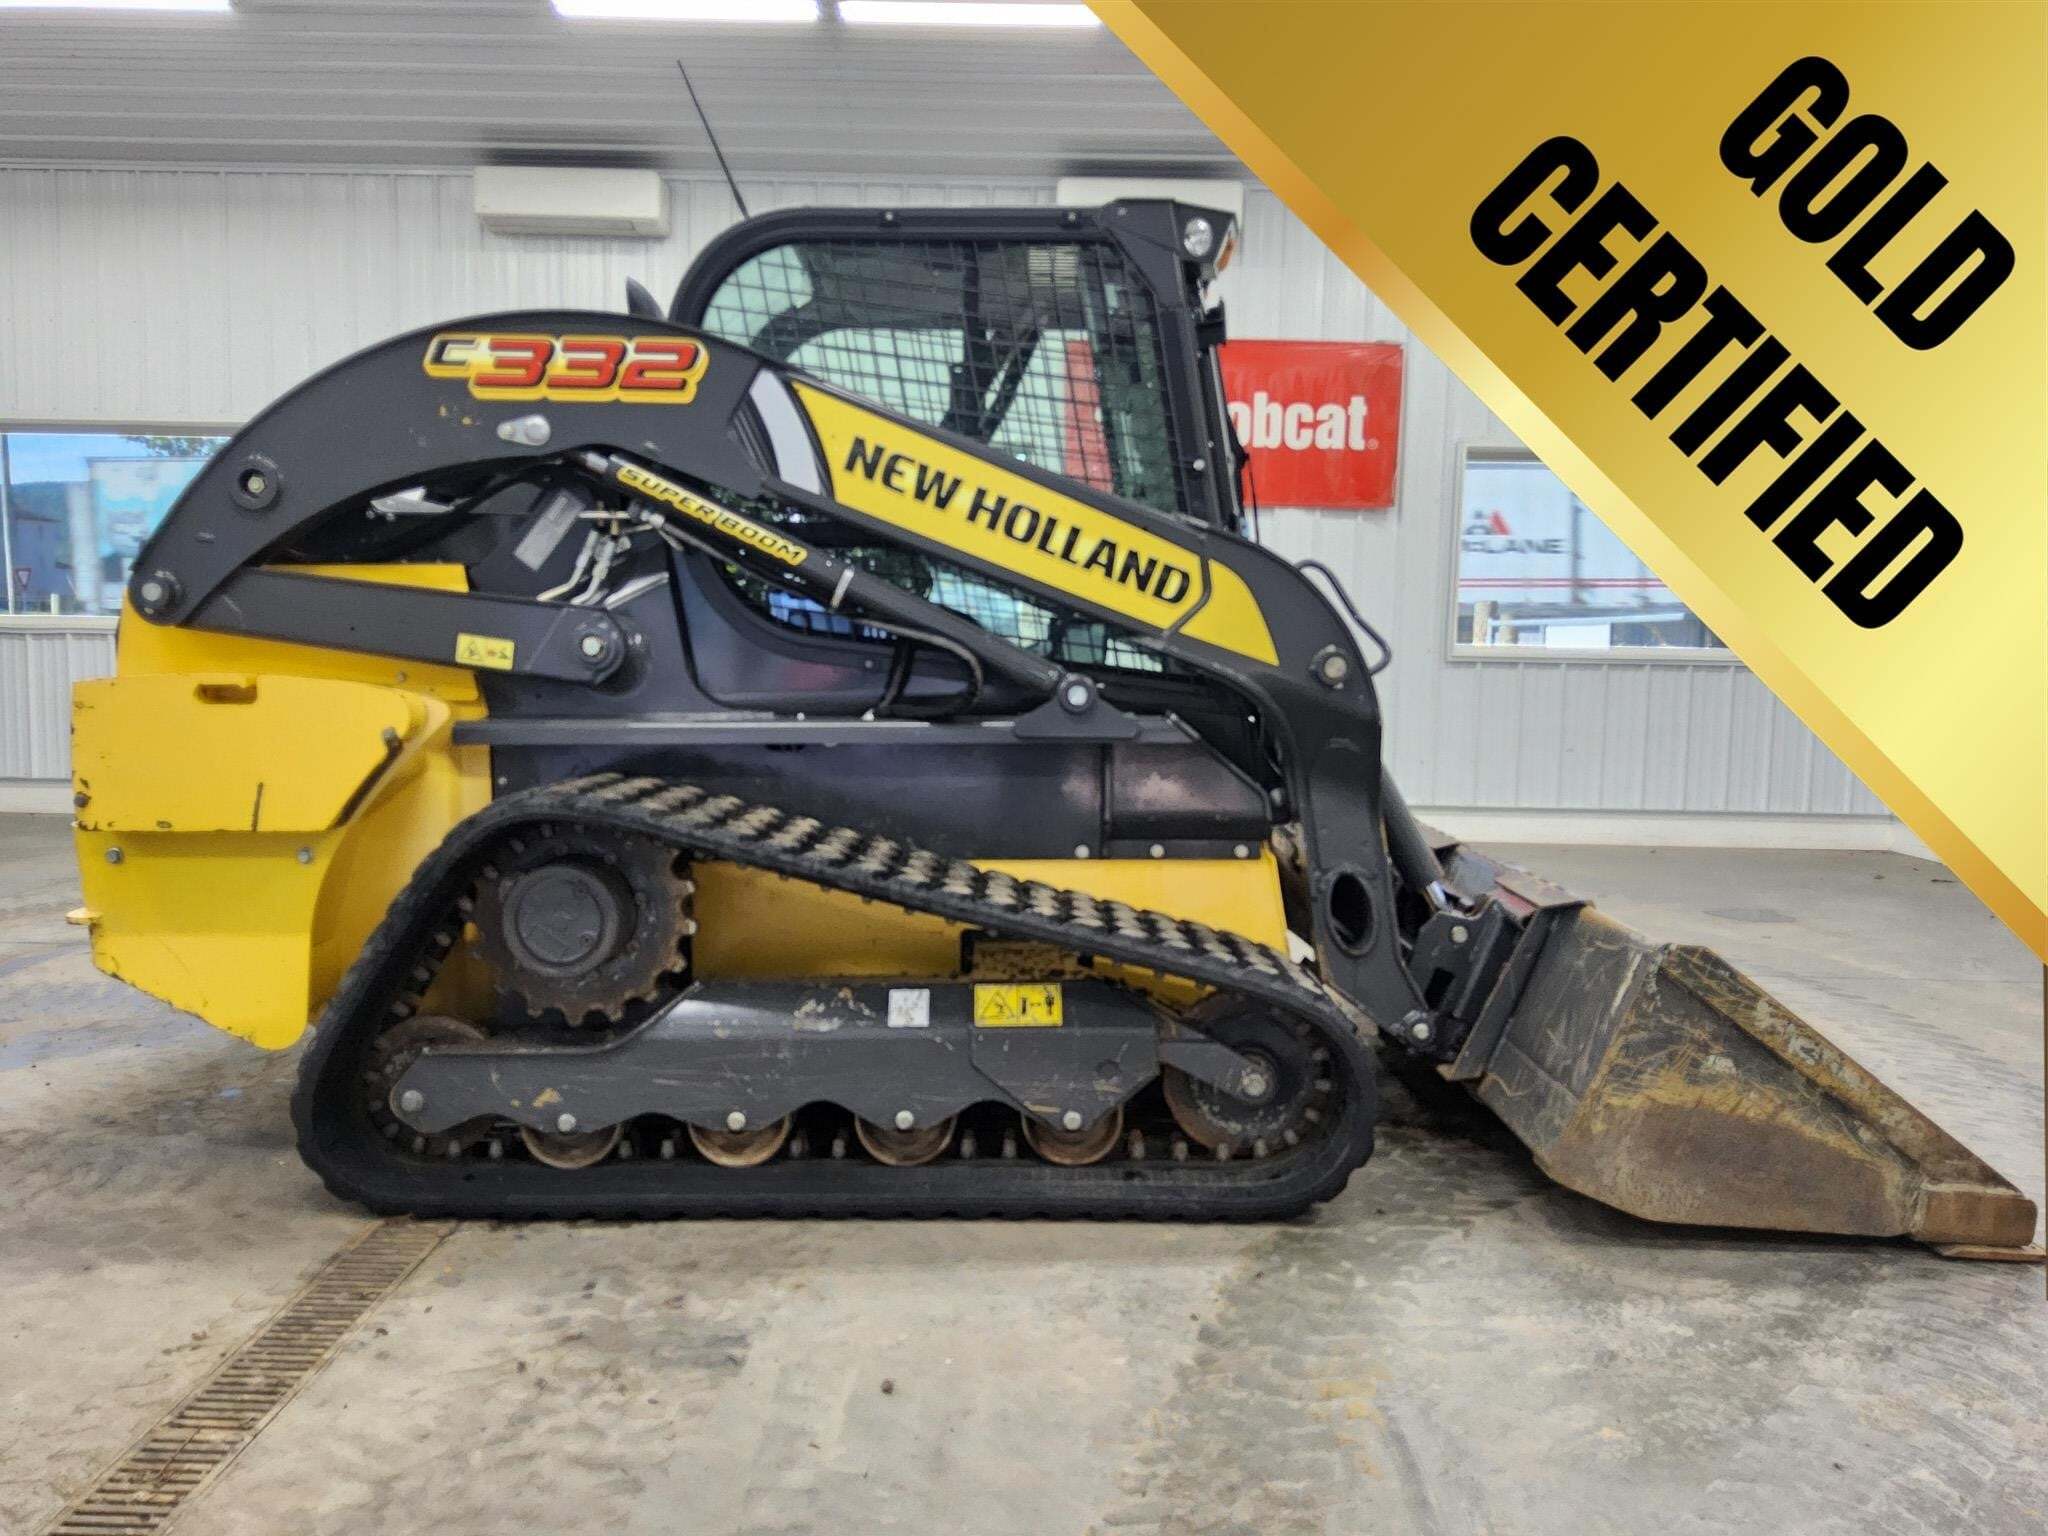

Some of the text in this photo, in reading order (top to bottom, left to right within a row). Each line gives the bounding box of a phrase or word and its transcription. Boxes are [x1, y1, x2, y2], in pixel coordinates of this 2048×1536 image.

[430, 337, 699, 390] C332
[1227, 391, 1368, 450] obcat
[844, 436, 1191, 605] NEW HOLLAND
